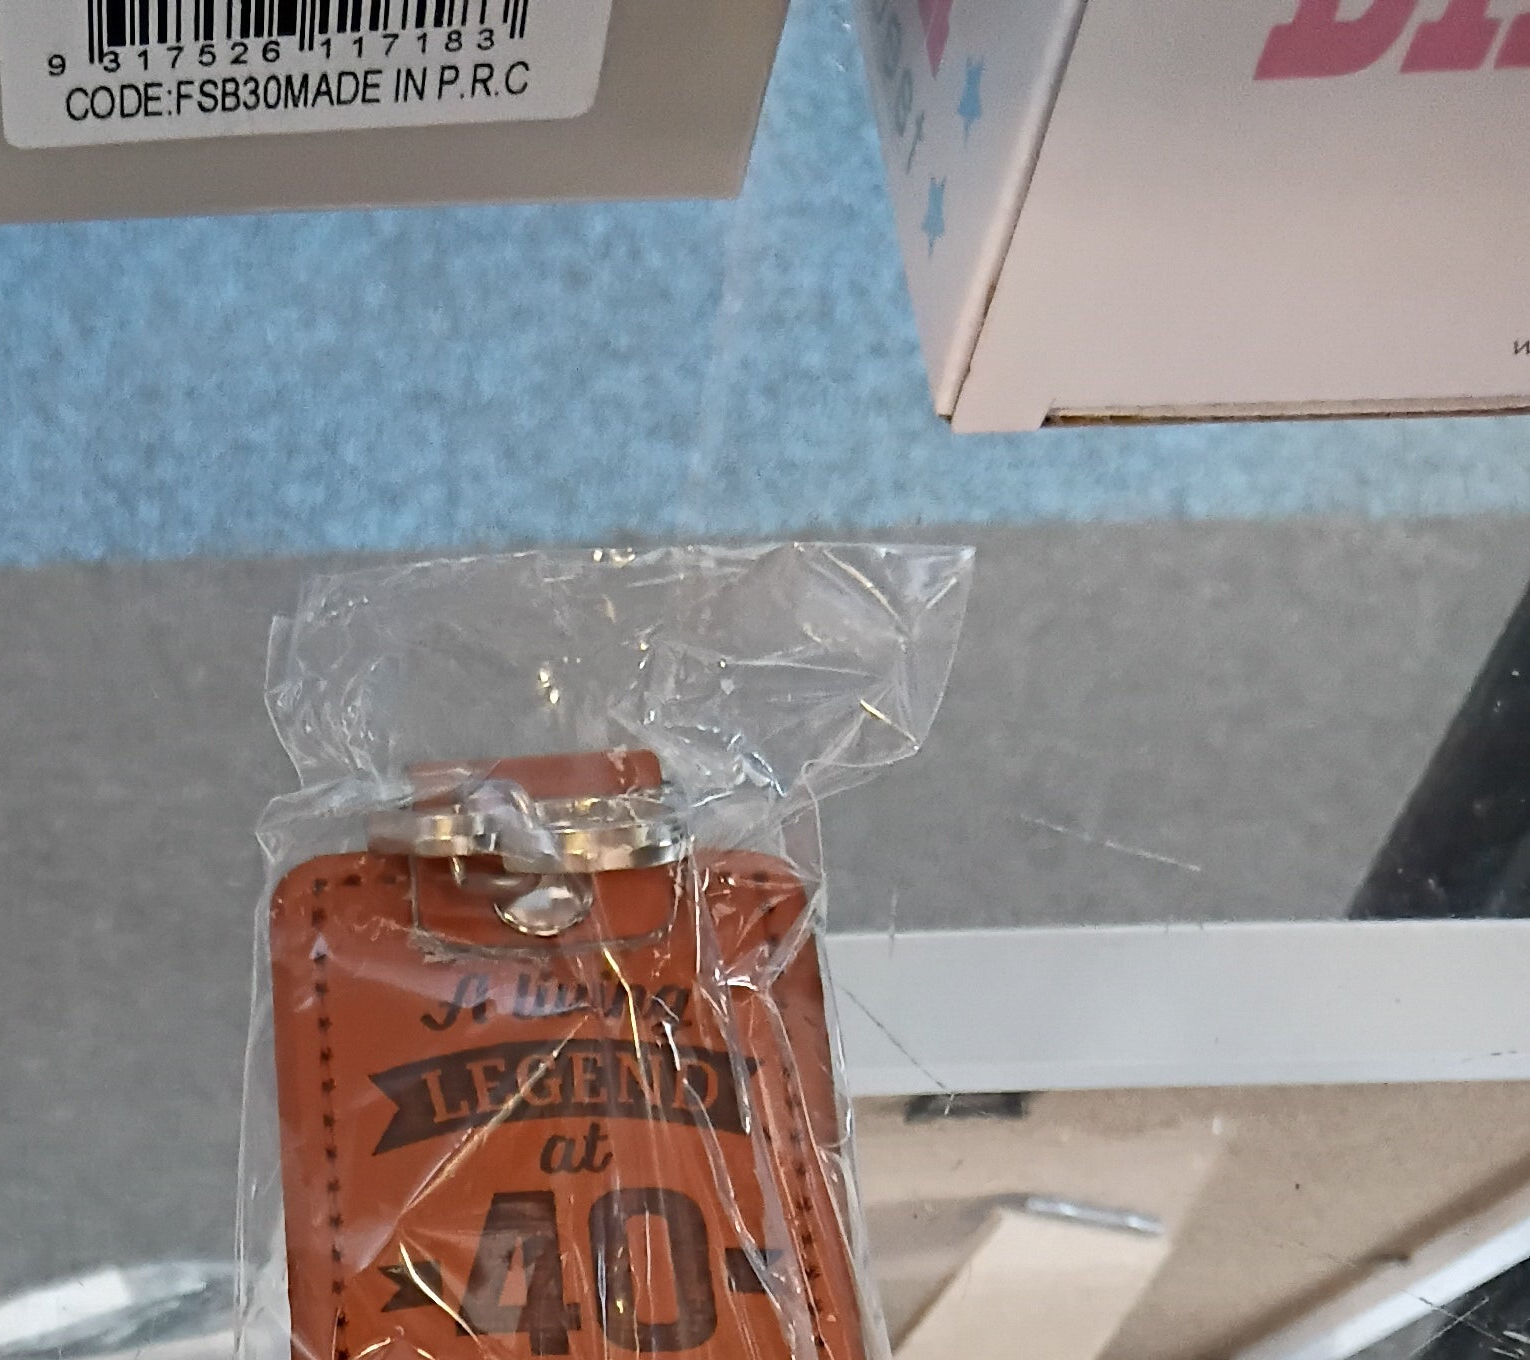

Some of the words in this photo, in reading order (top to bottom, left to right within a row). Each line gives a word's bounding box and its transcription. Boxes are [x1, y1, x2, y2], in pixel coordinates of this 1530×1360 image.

[48, 53, 66, 76] 9
[103, 41, 281, 73] 317526
[320, 28, 505, 59] 117183
[393, 66, 427, 103] IN
[438, 61, 530, 100] P.R.C
[422, 1056, 720, 1125] LEGEND
[539, 1122, 615, 1174] at
[456, 1187, 719, 1357] 40
